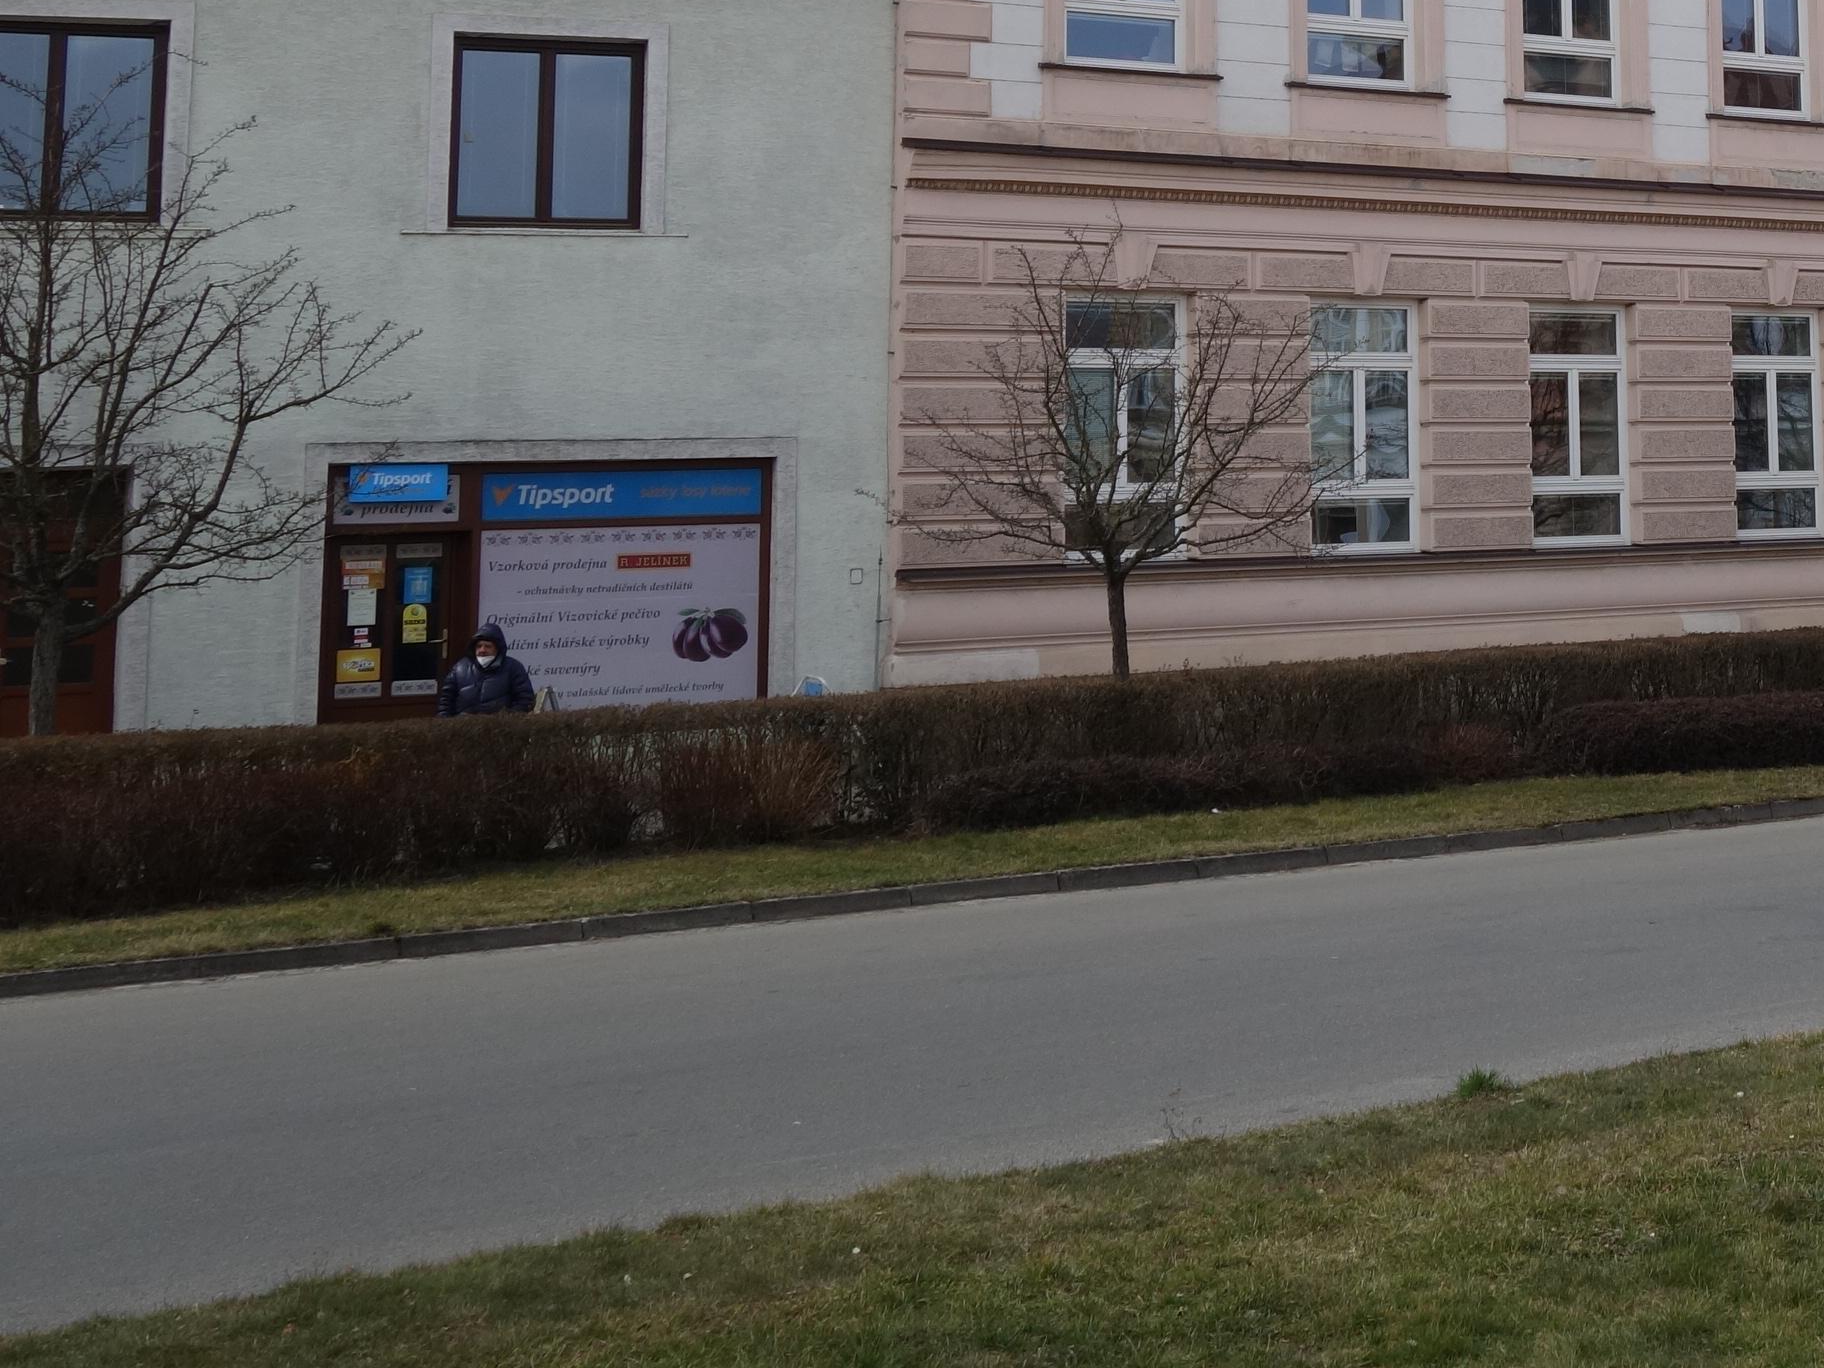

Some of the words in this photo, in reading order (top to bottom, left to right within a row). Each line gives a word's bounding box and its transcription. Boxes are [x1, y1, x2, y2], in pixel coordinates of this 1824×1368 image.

[373, 472, 433, 486] Tipsport
[518, 482, 615, 509] Tipsport
[488, 557, 549, 572] Vzorková
[551, 557, 608, 573] prodejna
[524, 584, 584, 597] ochutnávky
[586, 582, 647, 594] netradičních
[486, 611, 555, 628] Originální
[542, 635, 597, 650] sklářské
[598, 633, 651, 650] výrobky
[543, 662, 601, 677] suvenýry
